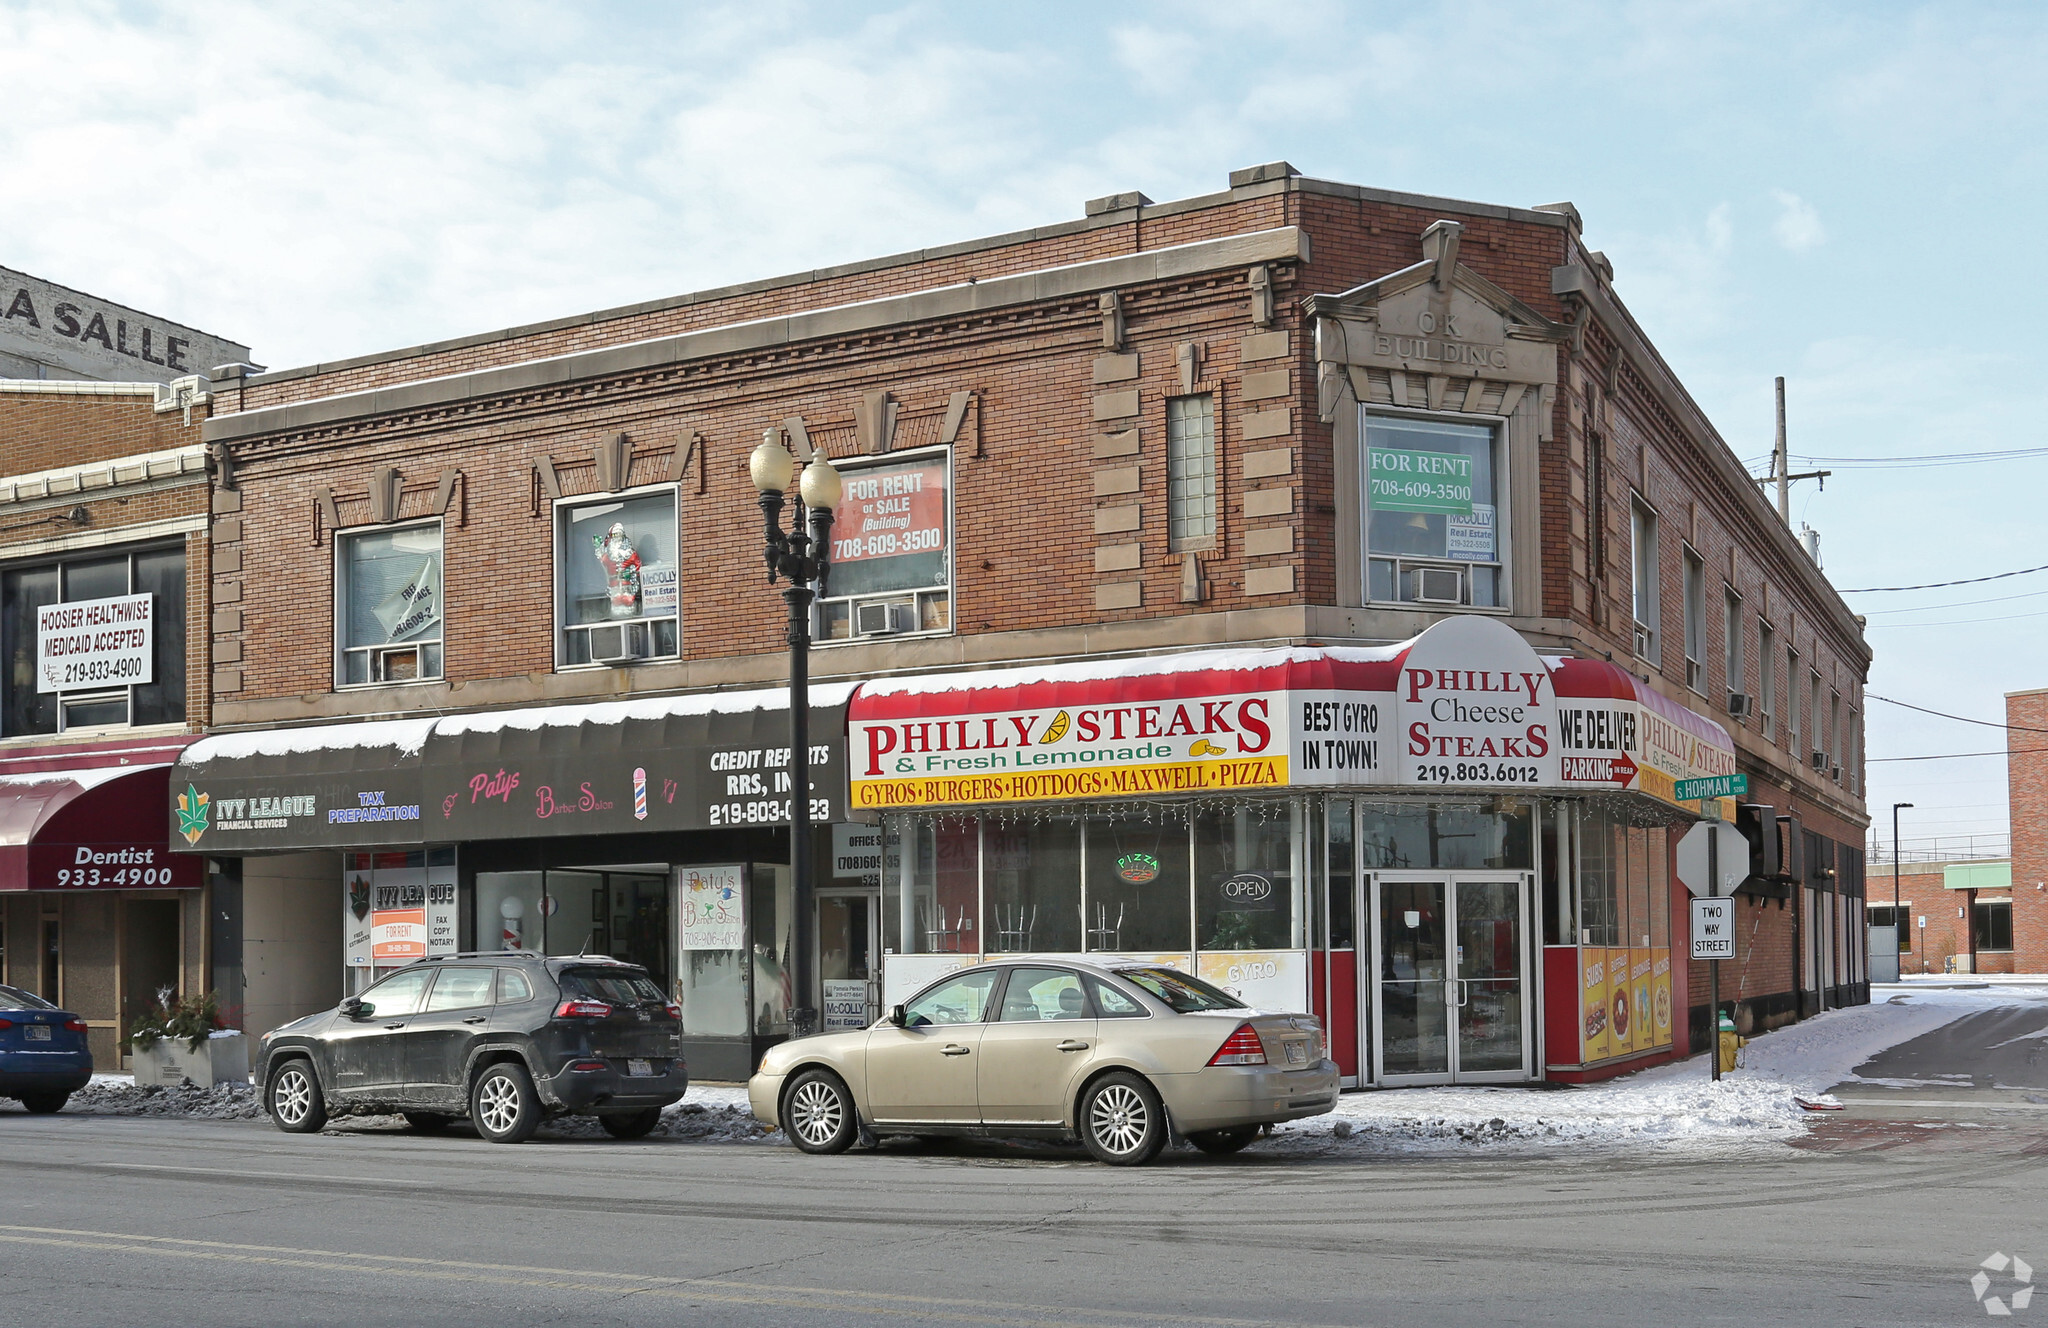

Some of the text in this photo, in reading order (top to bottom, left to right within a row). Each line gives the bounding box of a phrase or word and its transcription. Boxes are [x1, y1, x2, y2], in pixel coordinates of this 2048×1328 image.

[53, 302, 189, 372] SALLE
[1374, 335, 1508, 369] BUILDING
[1371, 452, 1470, 477] FOR RENT
[847, 472, 924, 502] FOR RENT
[1371, 479, 1471, 501] 708-609-3500
[863, 497, 911, 515] or SALE
[862, 514, 911, 533] (Building)
[1450, 528, 1492, 539] Real Estate
[834, 528, 941, 560] 708-609-3500
[1452, 552, 1490, 561] mccolly.com
[41, 600, 149, 632] HOOSIER HEALTHWISE
[45, 628, 145, 657] MEDICAID ACCEPTED
[65, 657, 142, 683] 219-933-4900
[1405, 668, 1545, 707] PHILLY
[1303, 702, 1378, 733] BEST GYRO
[1431, 697, 1524, 723] Cheese
[863, 698, 1271, 776] PHILLY STEAKS
[1409, 721, 1548, 758] STEAKS
[1559, 709, 1637, 751] WE DELIVER
[1640, 710, 1734, 776] PHILLY STEAKS
[710, 749, 762, 771] CREDIT
[895, 742, 1172, 773] & Fresh Lemonade
[1303, 740, 1378, 769] IN TOWN!
[1417, 762, 1538, 784] 219.803.6012
[1563, 758, 1634, 780] PARKING IN REAR
[1661, 755, 1682, 777] Fresh
[468, 768, 520, 804] Patys
[727, 771, 815, 797] RRS, IN.
[860, 761, 1278, 805] GYROS BURGERS HOTDOGS MAXWELL PIZZA
[1677, 777, 1730, 799] S HOHMAN
[216, 799, 246, 820] IVY
[249, 795, 316, 818] LEAGUE
[358, 791, 385, 806] TAX
[535, 782, 614, 818] Barber Salon
[328, 805, 420, 824] PREPARATION
[709, 799, 829, 825] 219-803-023
[217, 820, 253, 830] FINANCIAL
[254, 818, 288, 829] SERVICES
[849, 836, 875, 847] OFFICE
[75, 847, 155, 865] Dentist
[1117, 853, 1158, 871] PIZZA
[57, 868, 172, 886] 933-4900
[686, 870, 735, 894] Paty's
[377, 884, 455, 906] IVY LEAGUE
[1225, 881, 1266, 897] OPEN
[436, 916, 448, 924] FAX
[1702, 906, 1722, 918] TWO
[386, 924, 412, 938] FOR RENT
[433, 927, 450, 935] COPY
[1704, 924, 1720, 935] WAY
[430, 938, 455, 947] NOTARY
[1695, 940, 1730, 952] STREET
[1227, 960, 1277, 982] GYRO
[1586, 961, 1603, 989] SUBS
[826, 1003, 864, 1014] McCOLLY
[827, 1018, 841, 1026] Real
